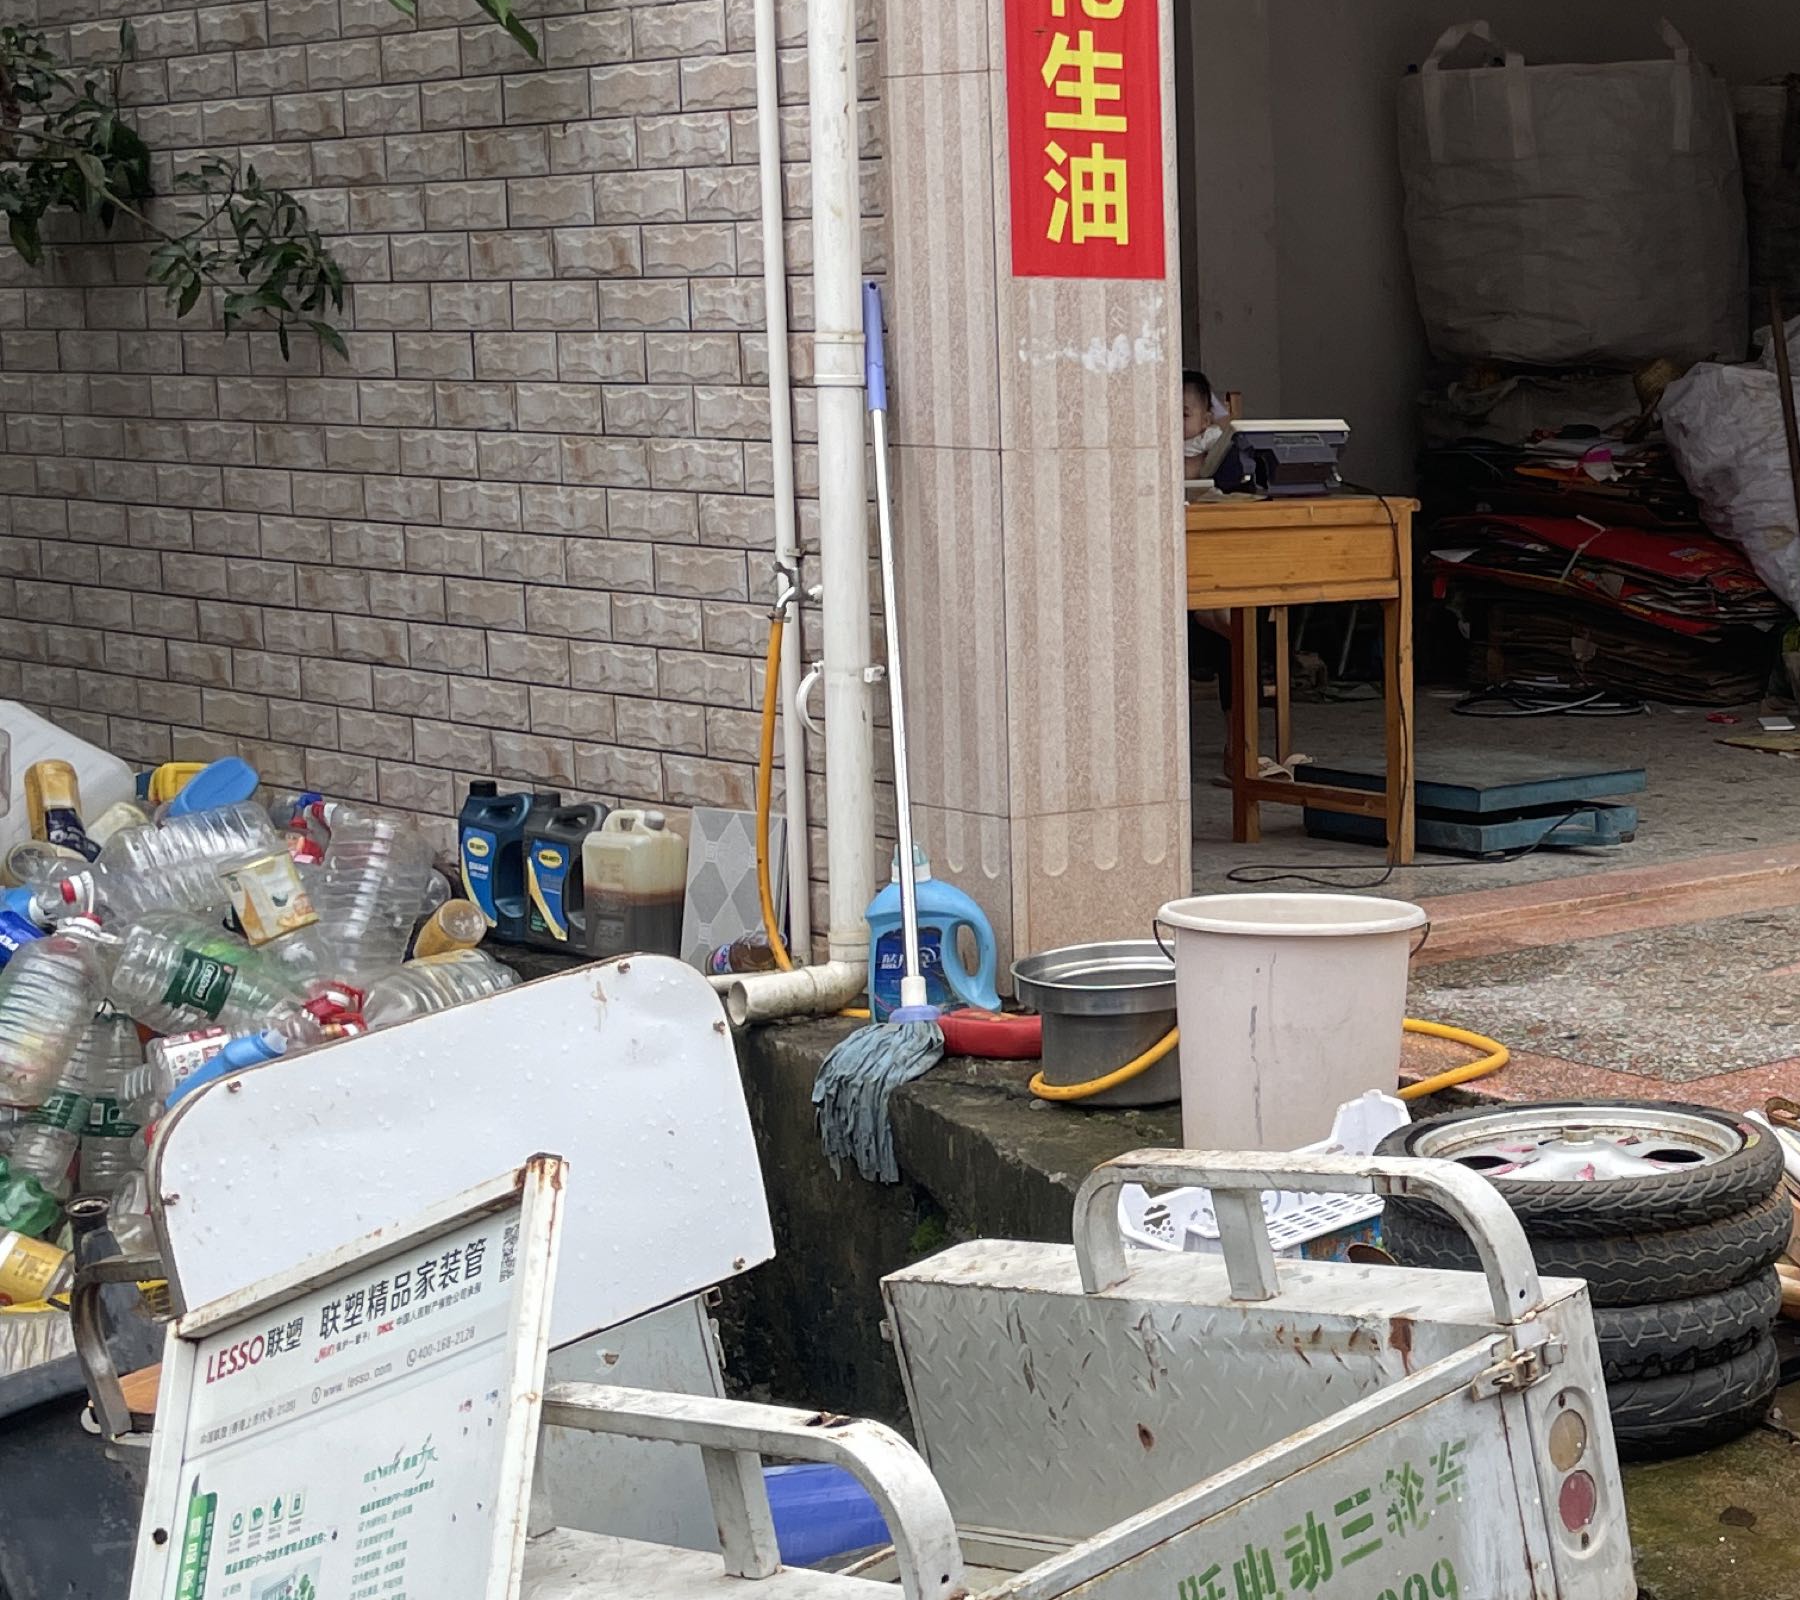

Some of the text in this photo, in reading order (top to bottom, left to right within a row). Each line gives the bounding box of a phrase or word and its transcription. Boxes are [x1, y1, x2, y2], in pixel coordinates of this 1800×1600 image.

[319, 1238, 488, 1340] 联塑精品家装管
